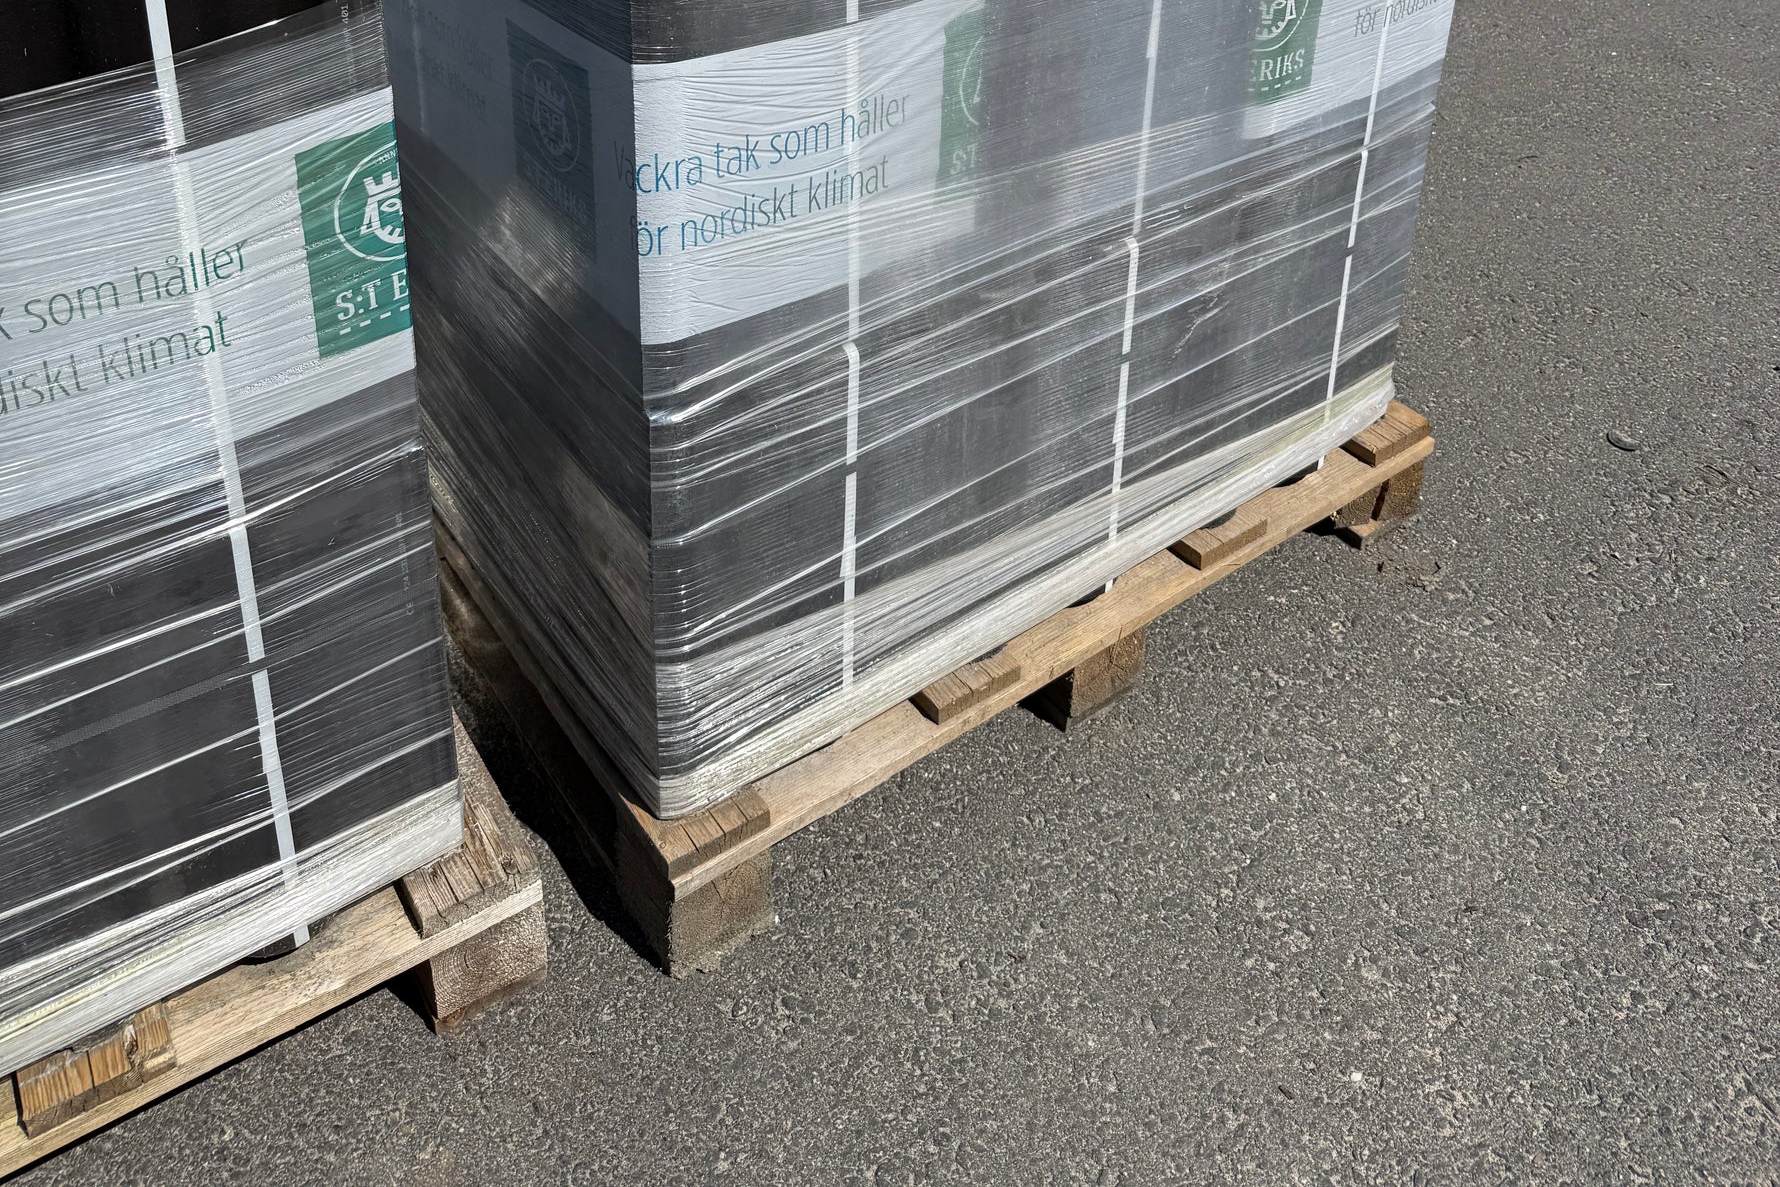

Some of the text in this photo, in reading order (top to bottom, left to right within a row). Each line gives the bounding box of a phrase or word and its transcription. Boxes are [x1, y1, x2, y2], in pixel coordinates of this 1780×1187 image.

[1354, 6, 1380, 38] för
[613, 94, 910, 194] Vackra tak som håller
[681, 183, 799, 251] nordiskt
[808, 154, 889, 214] klimat
[24, 280, 121, 334] som
[133, 239, 248, 304] håller
[98, 310, 232, 384] klimat
